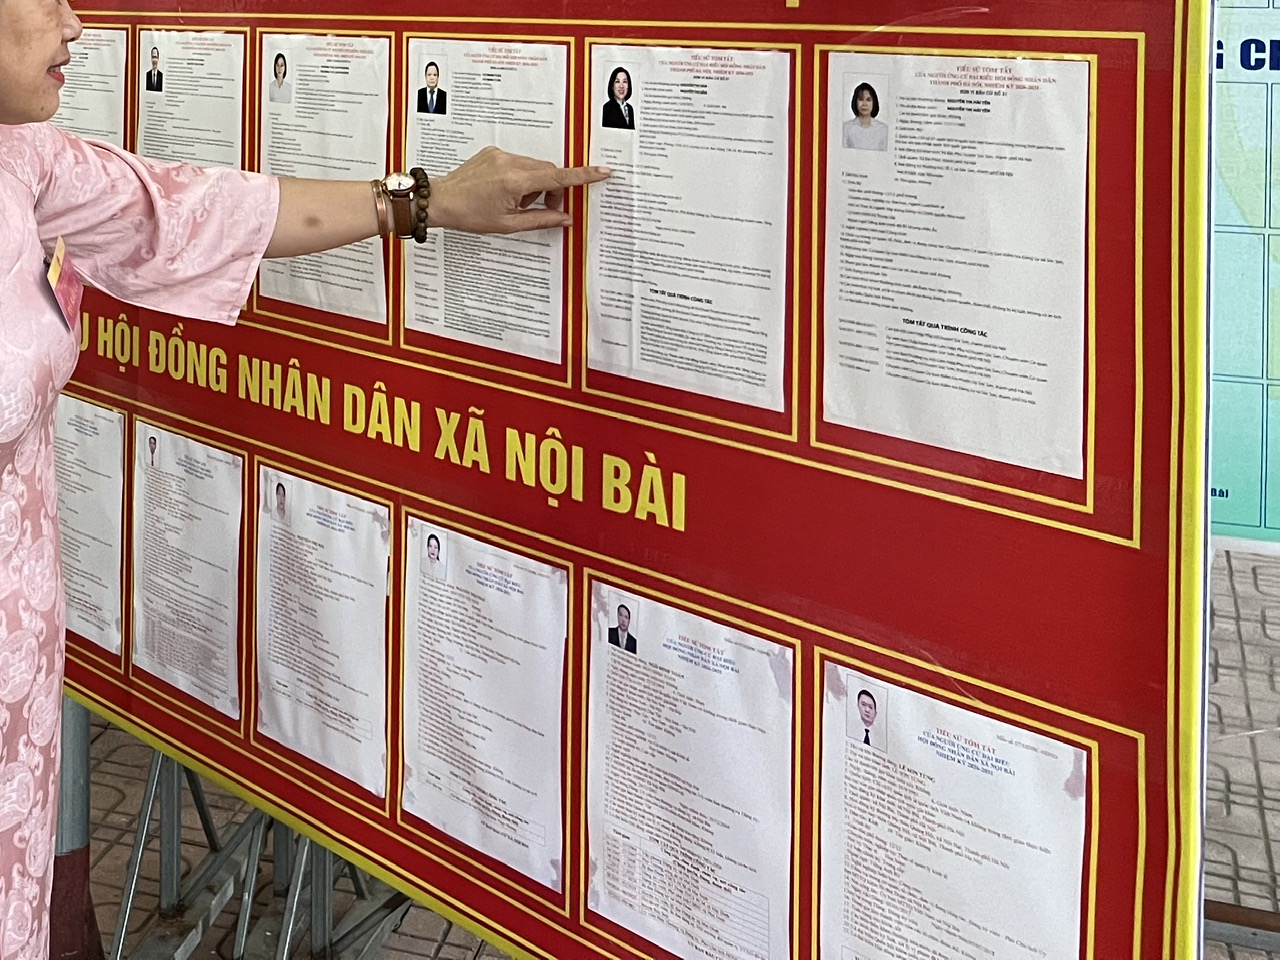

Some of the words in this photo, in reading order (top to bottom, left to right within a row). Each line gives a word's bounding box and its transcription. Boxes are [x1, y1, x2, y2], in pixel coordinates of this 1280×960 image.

[97, 313, 140, 373] HỘI
[148, 322, 227, 394] ĐỒNG
[238, 354, 332, 426] NHÂN
[343, 381, 422, 454] DÂN
[434, 406, 491, 475] XÃ
[505, 426, 585, 508] NỘI
[602, 450, 687, 533] BÀI
